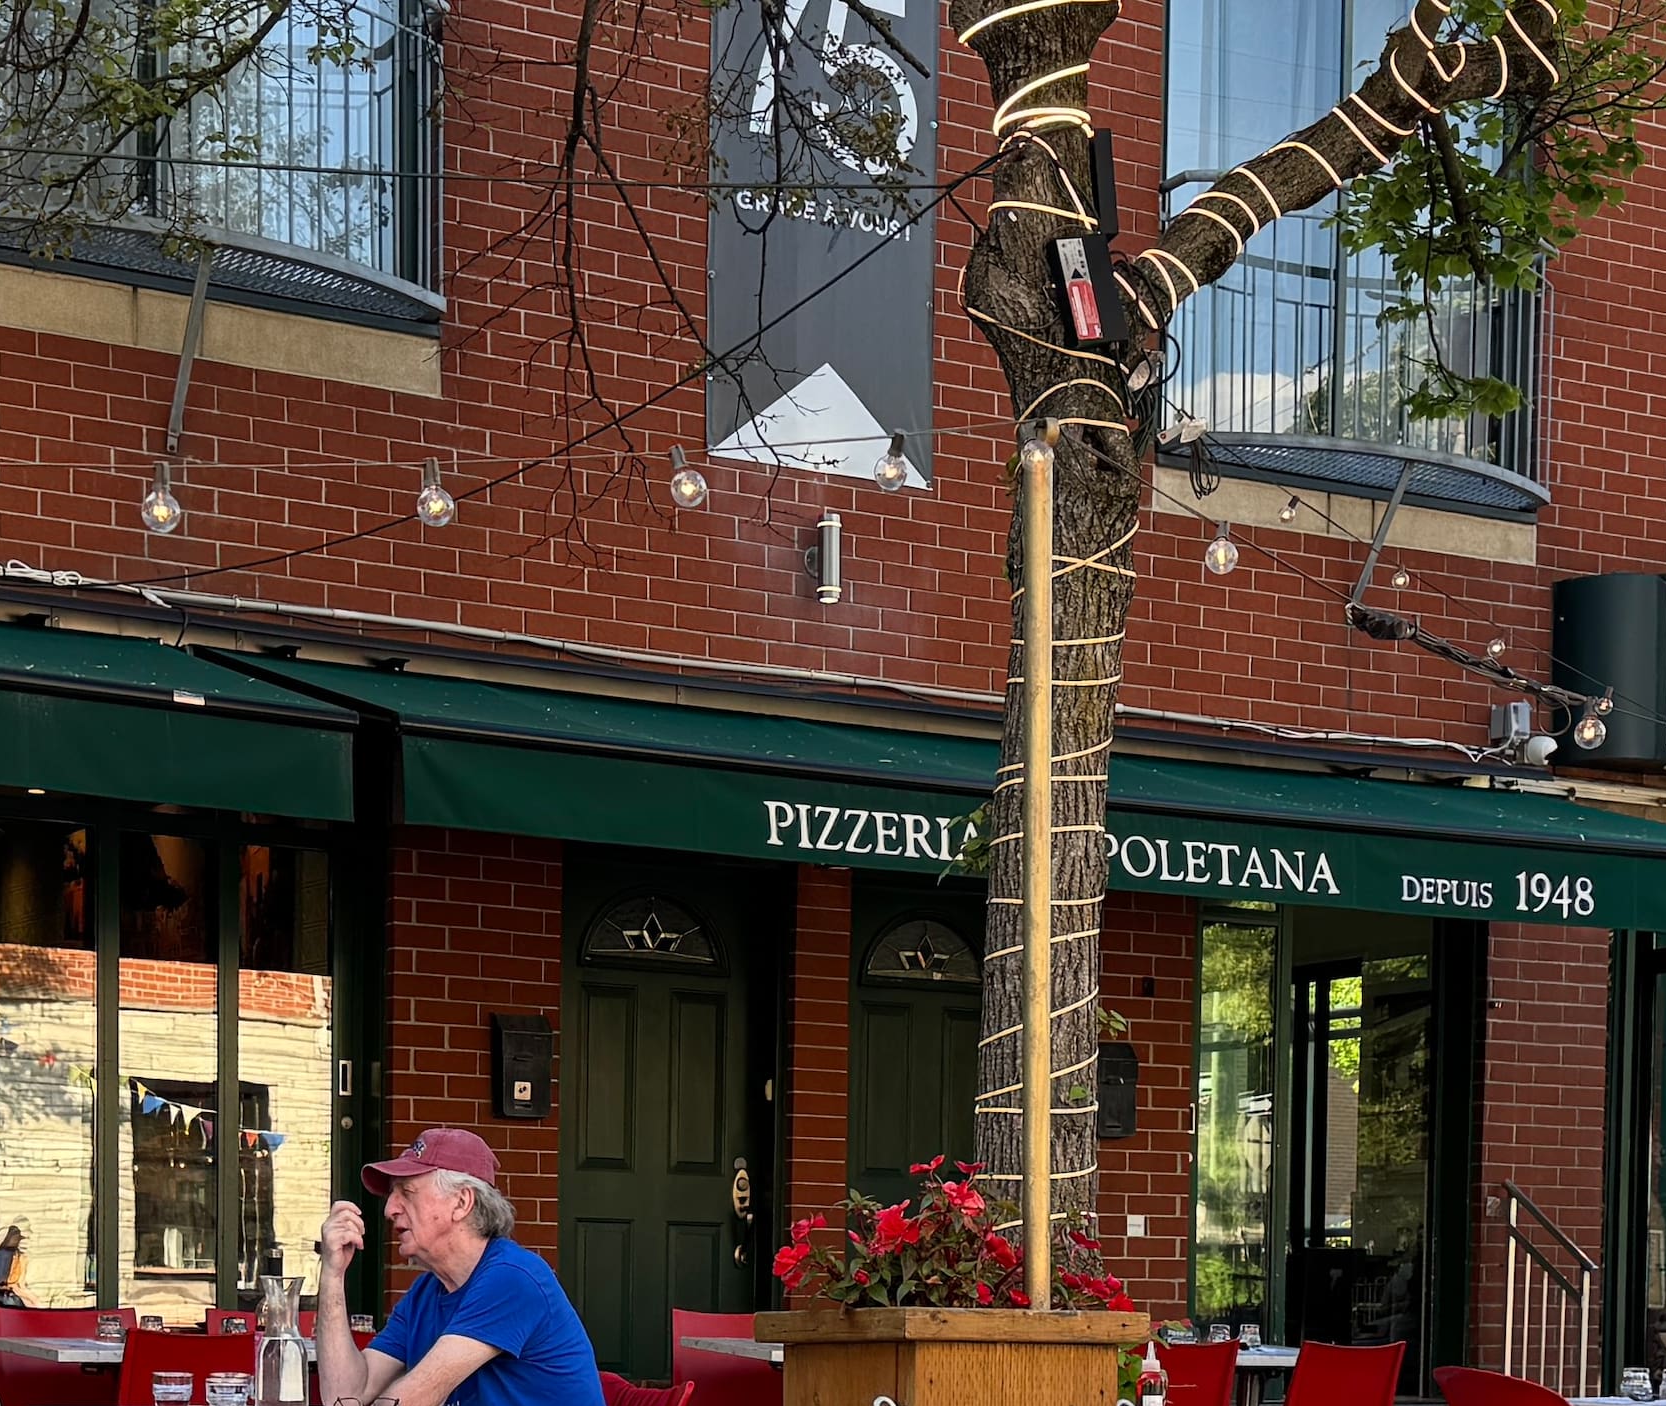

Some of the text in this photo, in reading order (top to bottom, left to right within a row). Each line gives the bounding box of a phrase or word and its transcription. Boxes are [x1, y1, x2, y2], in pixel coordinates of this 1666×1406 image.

[1104, 834, 1339, 894] OLETANA
[1402, 876, 1492, 909] DEPUIS
[1516, 872, 1594, 919] 1948
